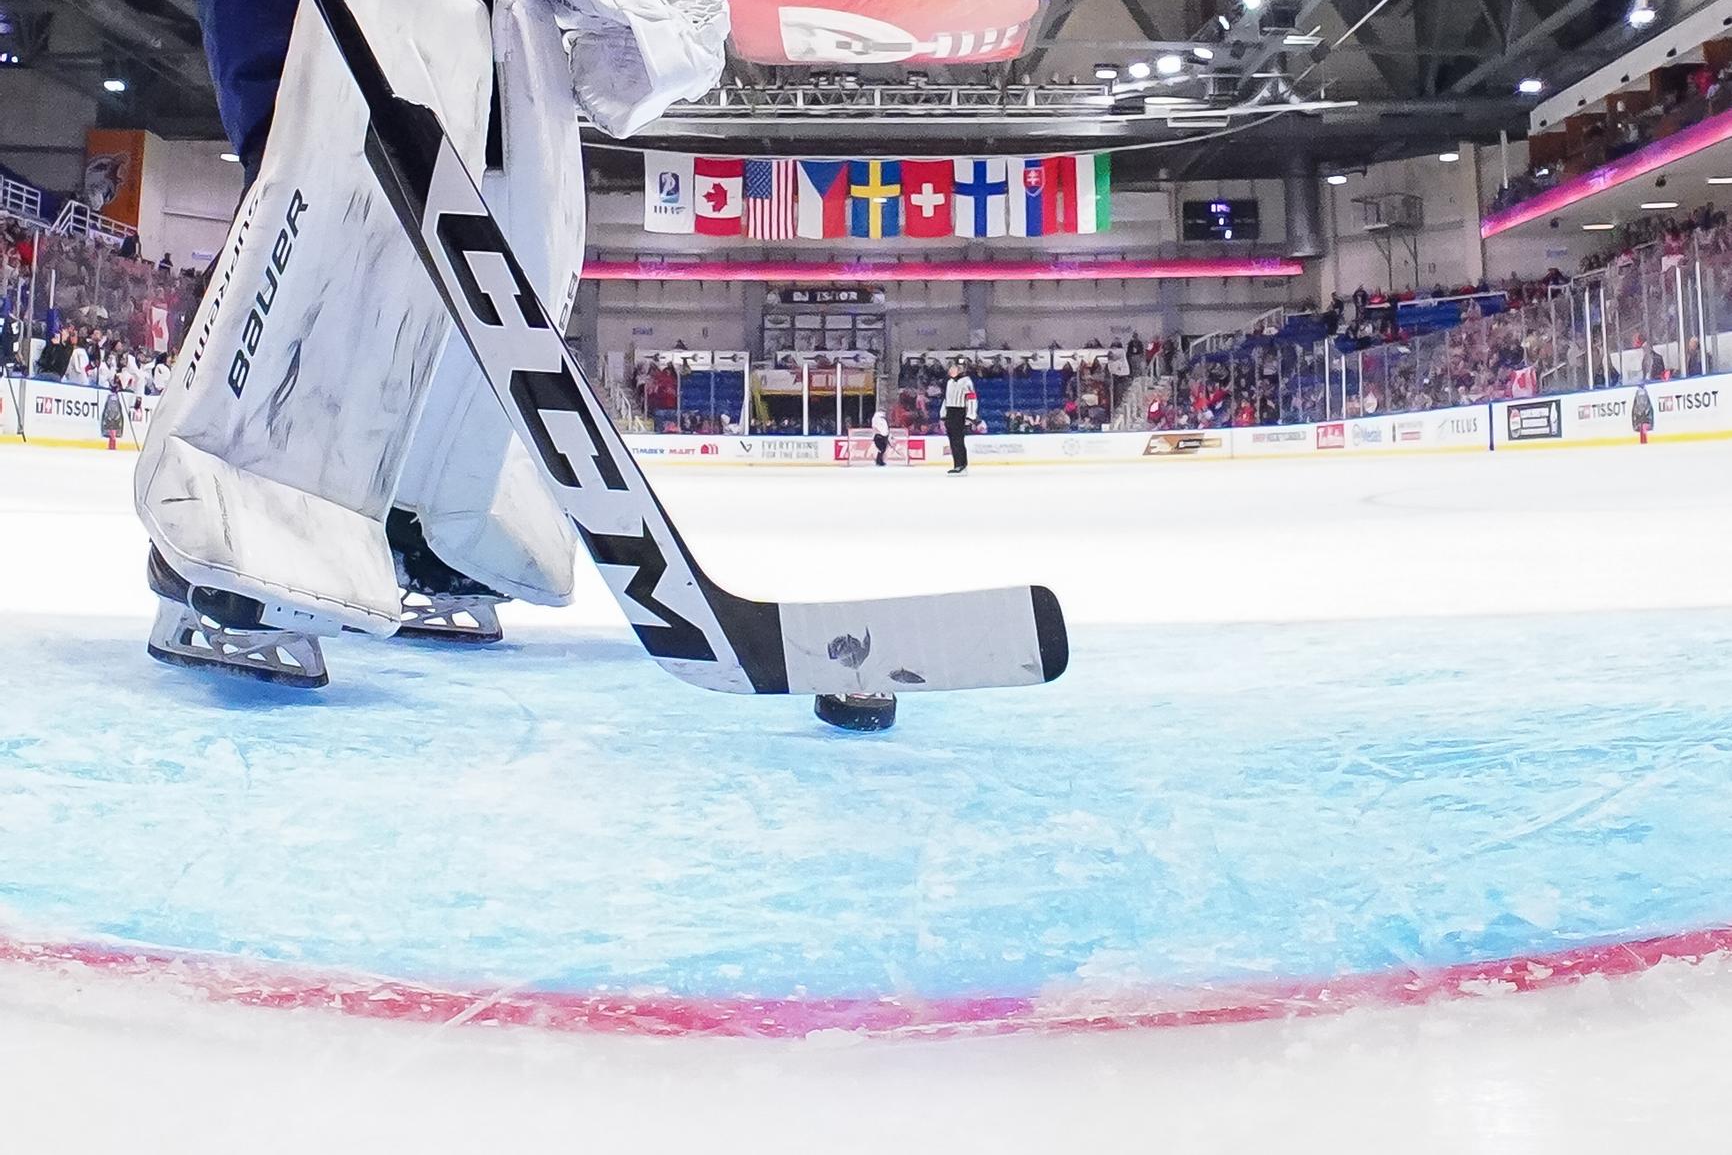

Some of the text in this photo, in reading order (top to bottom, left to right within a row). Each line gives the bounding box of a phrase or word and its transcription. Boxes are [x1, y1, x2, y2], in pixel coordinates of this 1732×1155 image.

[55, 398, 98, 421] TISSOT
[1591, 400, 1627, 418] TISSOT
[1675, 390, 1719, 410] TISSOT
[1450, 417, 1478, 434] TELUS
[436, 212, 718, 662] CCM
